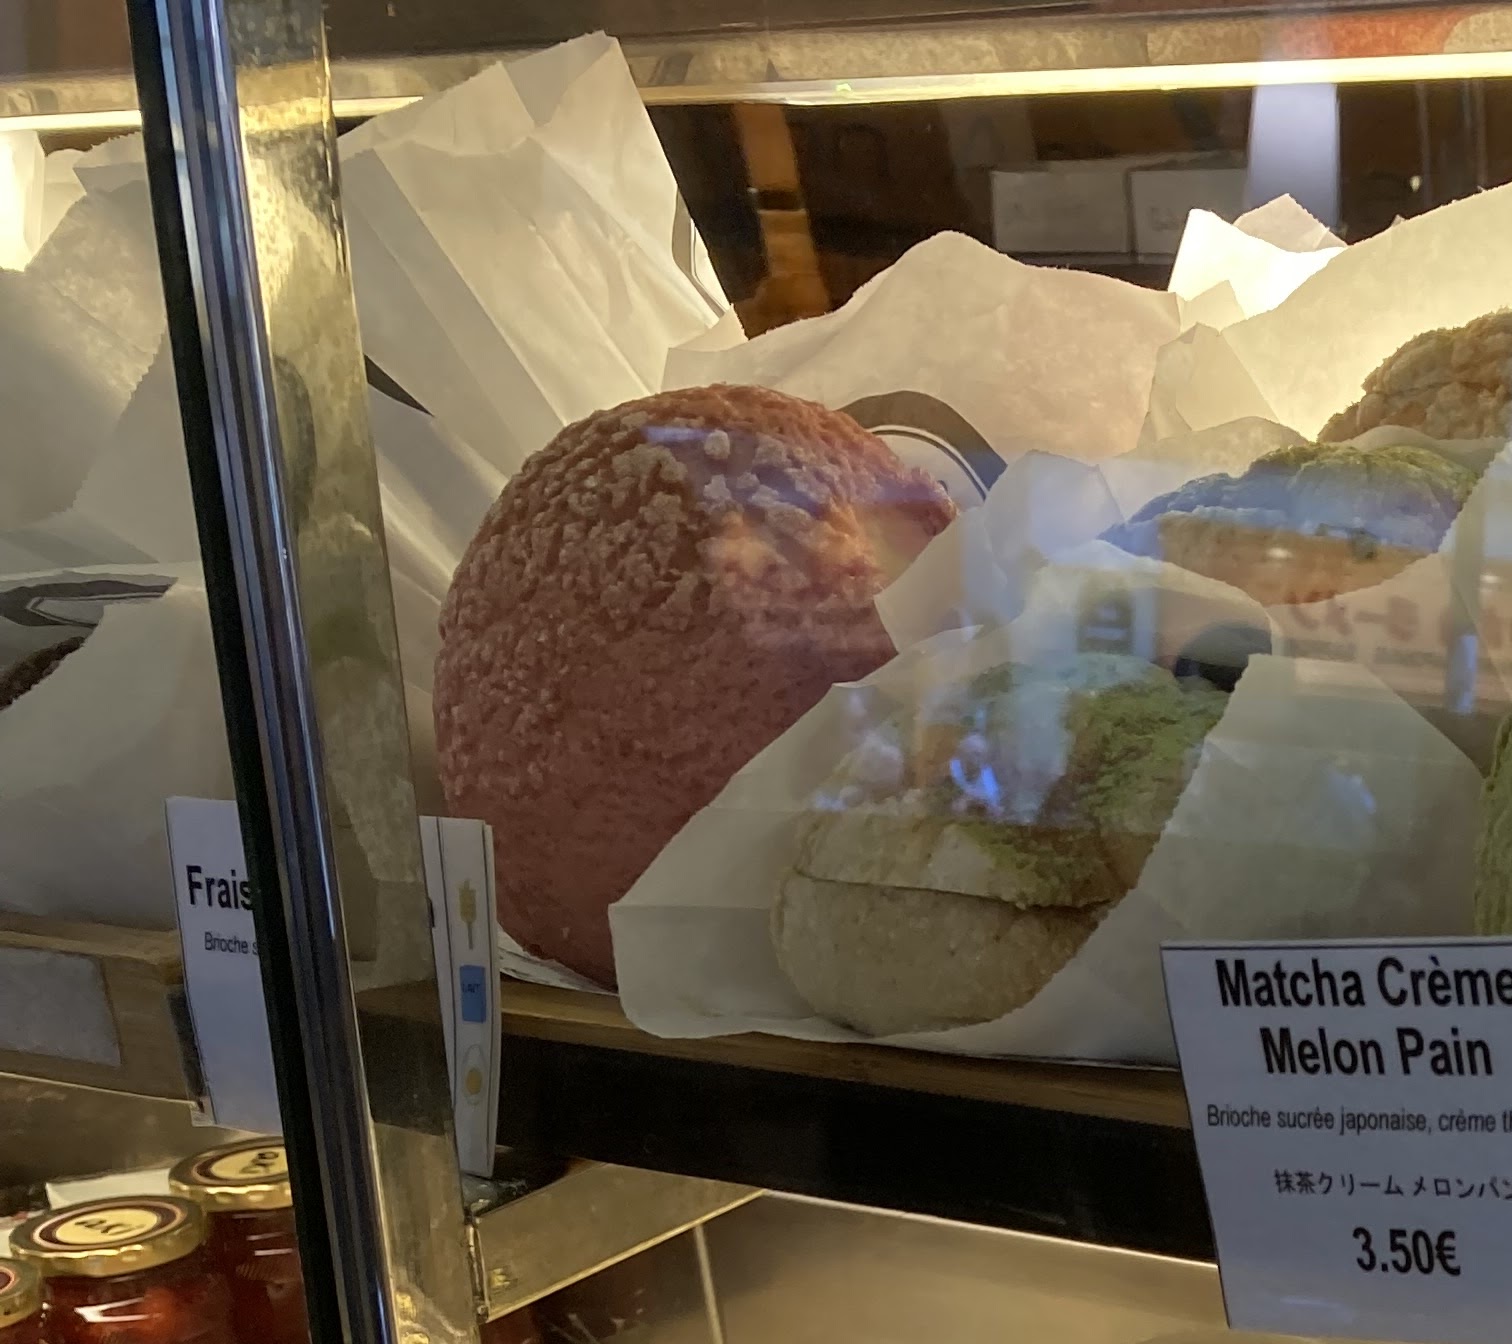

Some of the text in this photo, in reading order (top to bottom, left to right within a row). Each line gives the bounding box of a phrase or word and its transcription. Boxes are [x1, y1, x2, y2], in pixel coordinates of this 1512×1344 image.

[204, 931, 249, 954] Brioche
[1215, 957, 1365, 1008] Matcha
[1260, 1027, 1493, 1077] Melon Pain
[1207, 1104, 1271, 1129] Brioche
[1276, 1106, 1334, 1130] sucrée
[1339, 1107, 1432, 1135] japonaise,
[1438, 1108, 1496, 1133] crème
[1352, 1227, 1461, 1276] 3.50€
